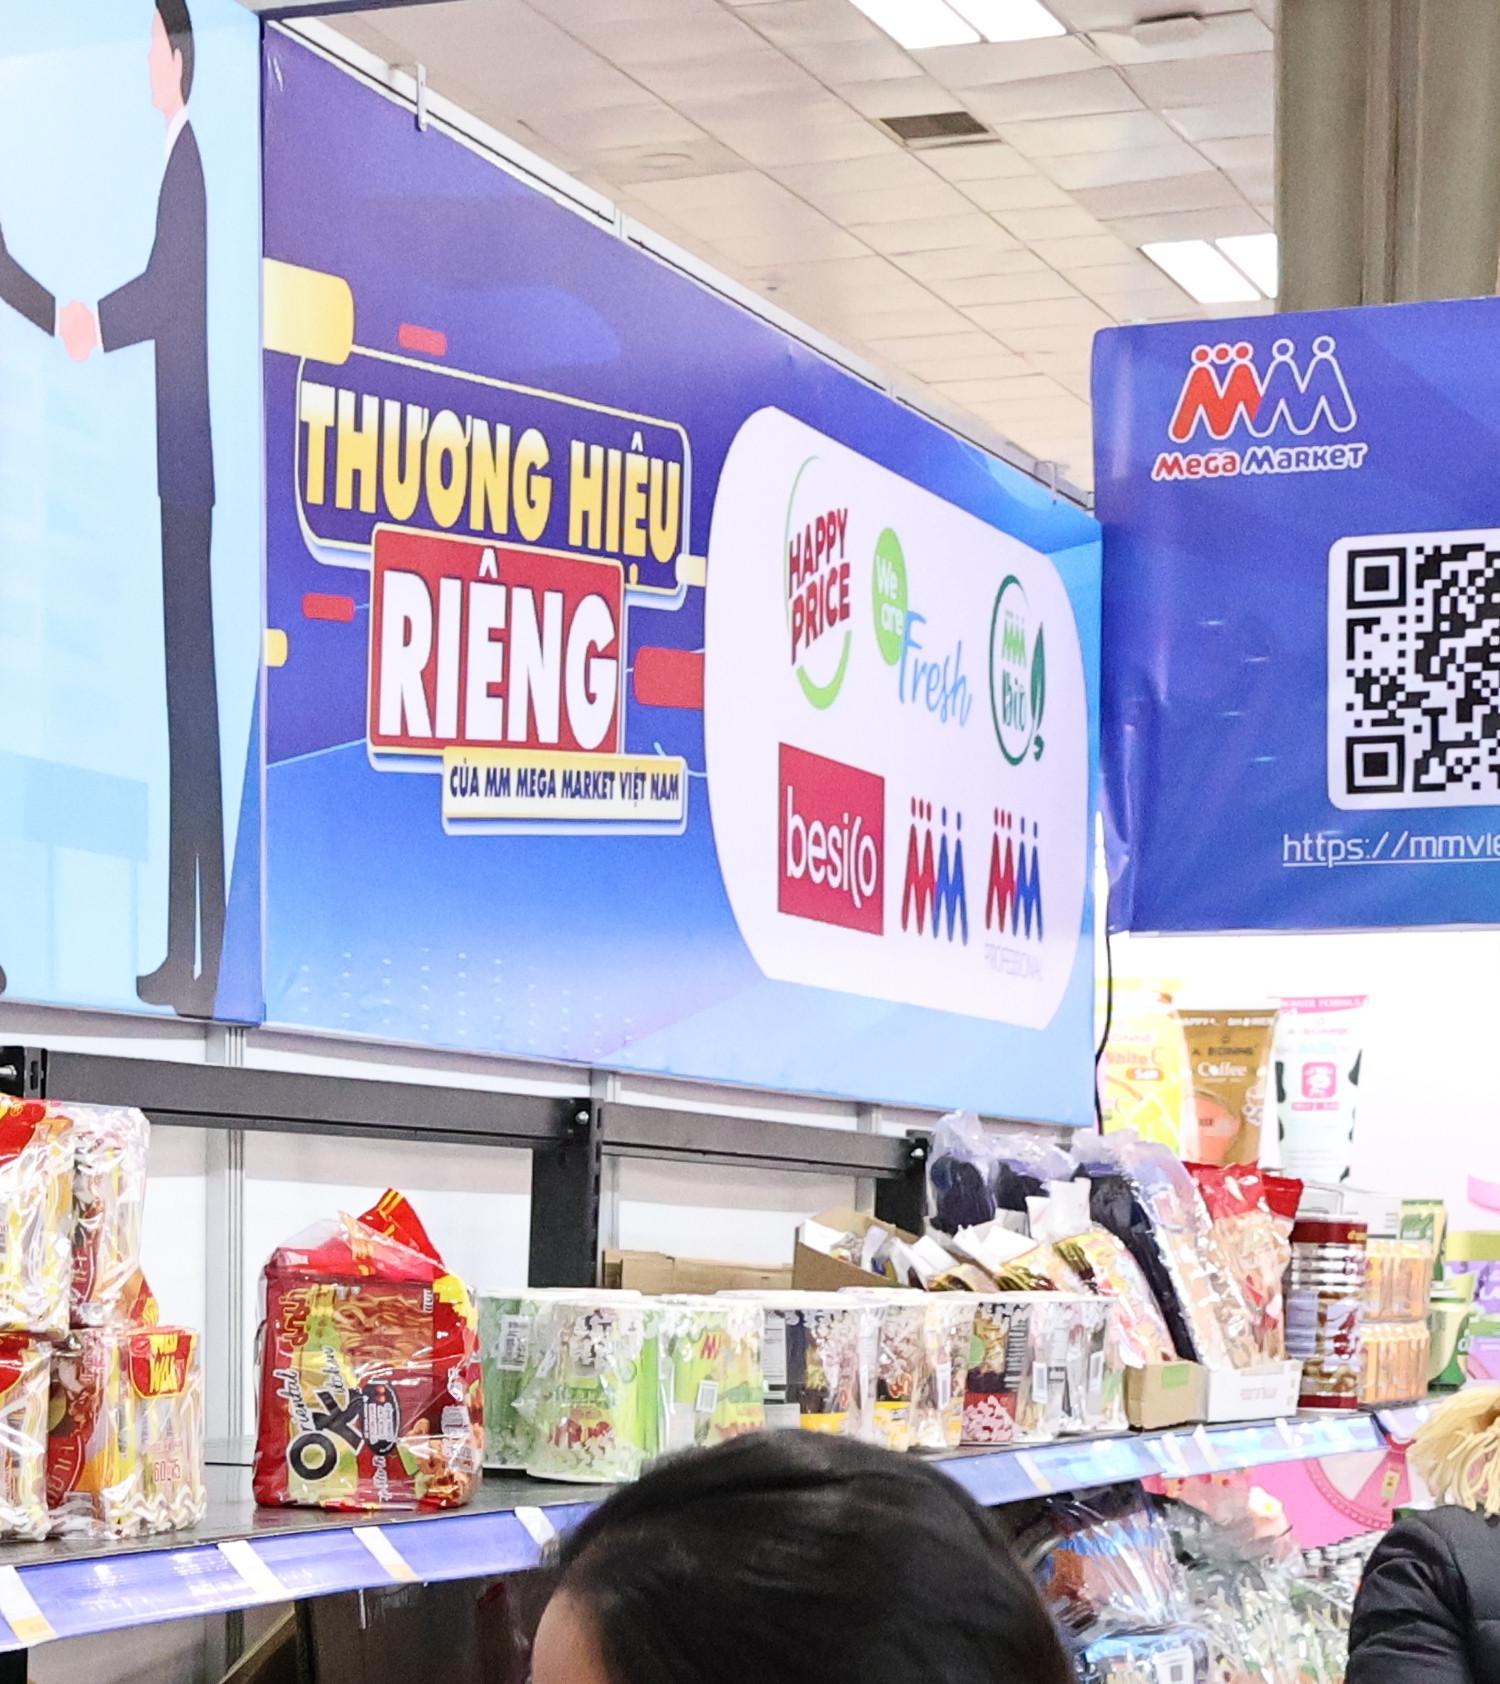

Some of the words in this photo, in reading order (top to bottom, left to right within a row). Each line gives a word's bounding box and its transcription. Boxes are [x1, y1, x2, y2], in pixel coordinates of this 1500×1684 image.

[299, 380, 554, 542] THƯƠNG
[566, 430, 681, 586] HIỆU
[787, 507, 849, 599] HAPPY
[875, 554, 898, 602] We
[378, 546, 618, 752] RIÊNG
[790, 560, 852, 667] PRICE
[880, 600, 904, 636] are
[898, 610, 974, 729] Fresh
[449, 757, 480, 799] CỦA
[483, 766, 512, 799] MM
[515, 767, 558, 800] MEGA
[560, 769, 616, 802] MARKET
[618, 766, 647, 808] VIỆT
[649, 771, 680, 802] NAM
[1197, 1060, 1248, 1078] Coffee
